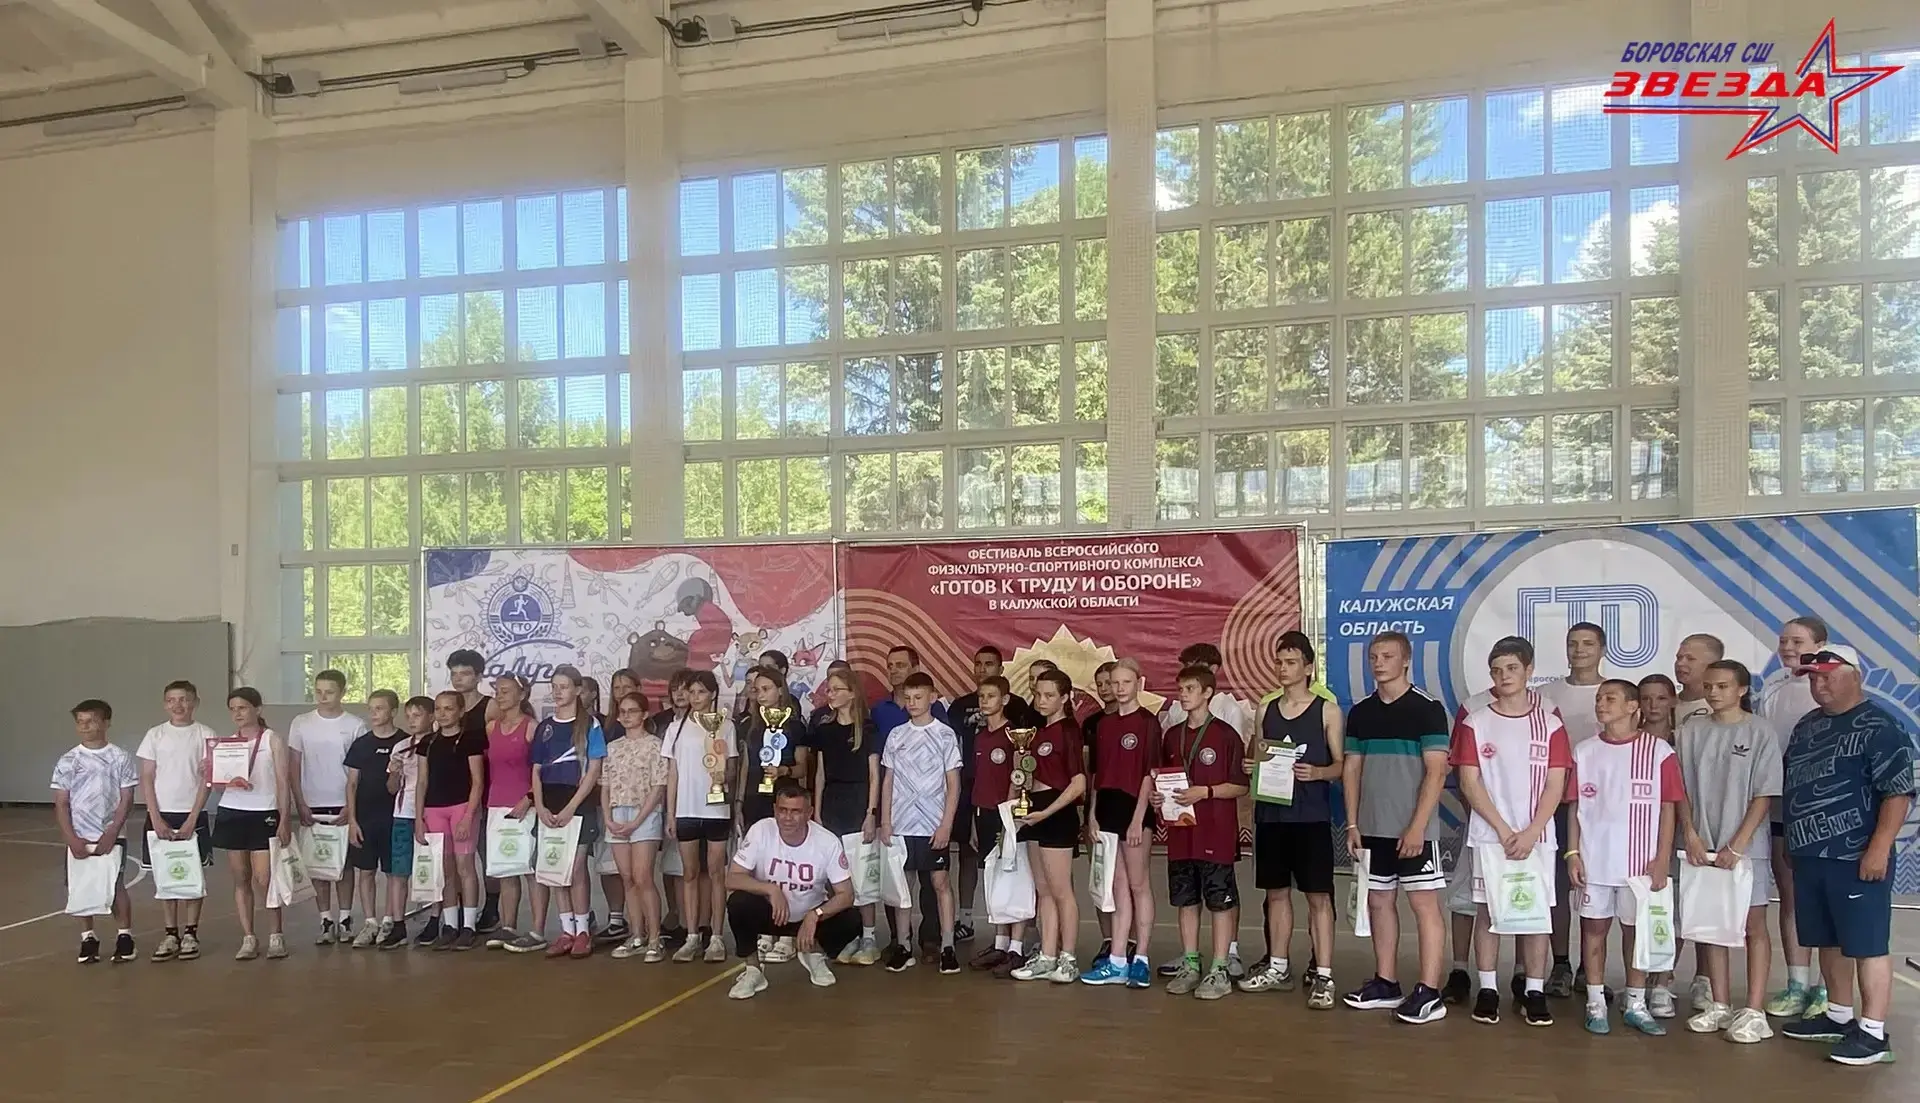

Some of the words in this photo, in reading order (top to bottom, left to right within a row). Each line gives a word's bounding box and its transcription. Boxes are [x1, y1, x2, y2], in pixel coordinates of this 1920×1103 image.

[968, 548, 1042, 560] ФЕСТИВАЛЬ
[1044, 542, 1159, 557] ВСЕРОССИЙСКОГО
[928, 559, 1121, 575] ФИЗКУЛЬТУРНО-СПОРТИВНОГО
[1124, 556, 1204, 570] КОМПЛЕКСА
[930, 579, 997, 595] «ГОТОВ
[1001, 579, 1014, 594] К
[1017, 576, 1078, 594] ТРУДУ
[1082, 576, 1096, 591] И
[1100, 573, 1202, 591] ОБОРОНЕ»
[988, 600, 997, 610] В
[1000, 596, 1077, 610] КАЛУЖСКОЙ
[1080, 596, 1139, 608] ОБЛАСТИ
[1339, 596, 1454, 613] КАЛУЖСКАЯ
[511, 622, 532, 631] ГТО
[1339, 620, 1425, 636] ОБЛАСТЬ
[1529, 744, 1547, 758] ГТО
[1631, 783, 1652, 796] ГТО
[1828, 807, 1863, 836] NIKE
[1786, 811, 1832, 851] NIKE
[769, 858, 814, 882] ГТО
